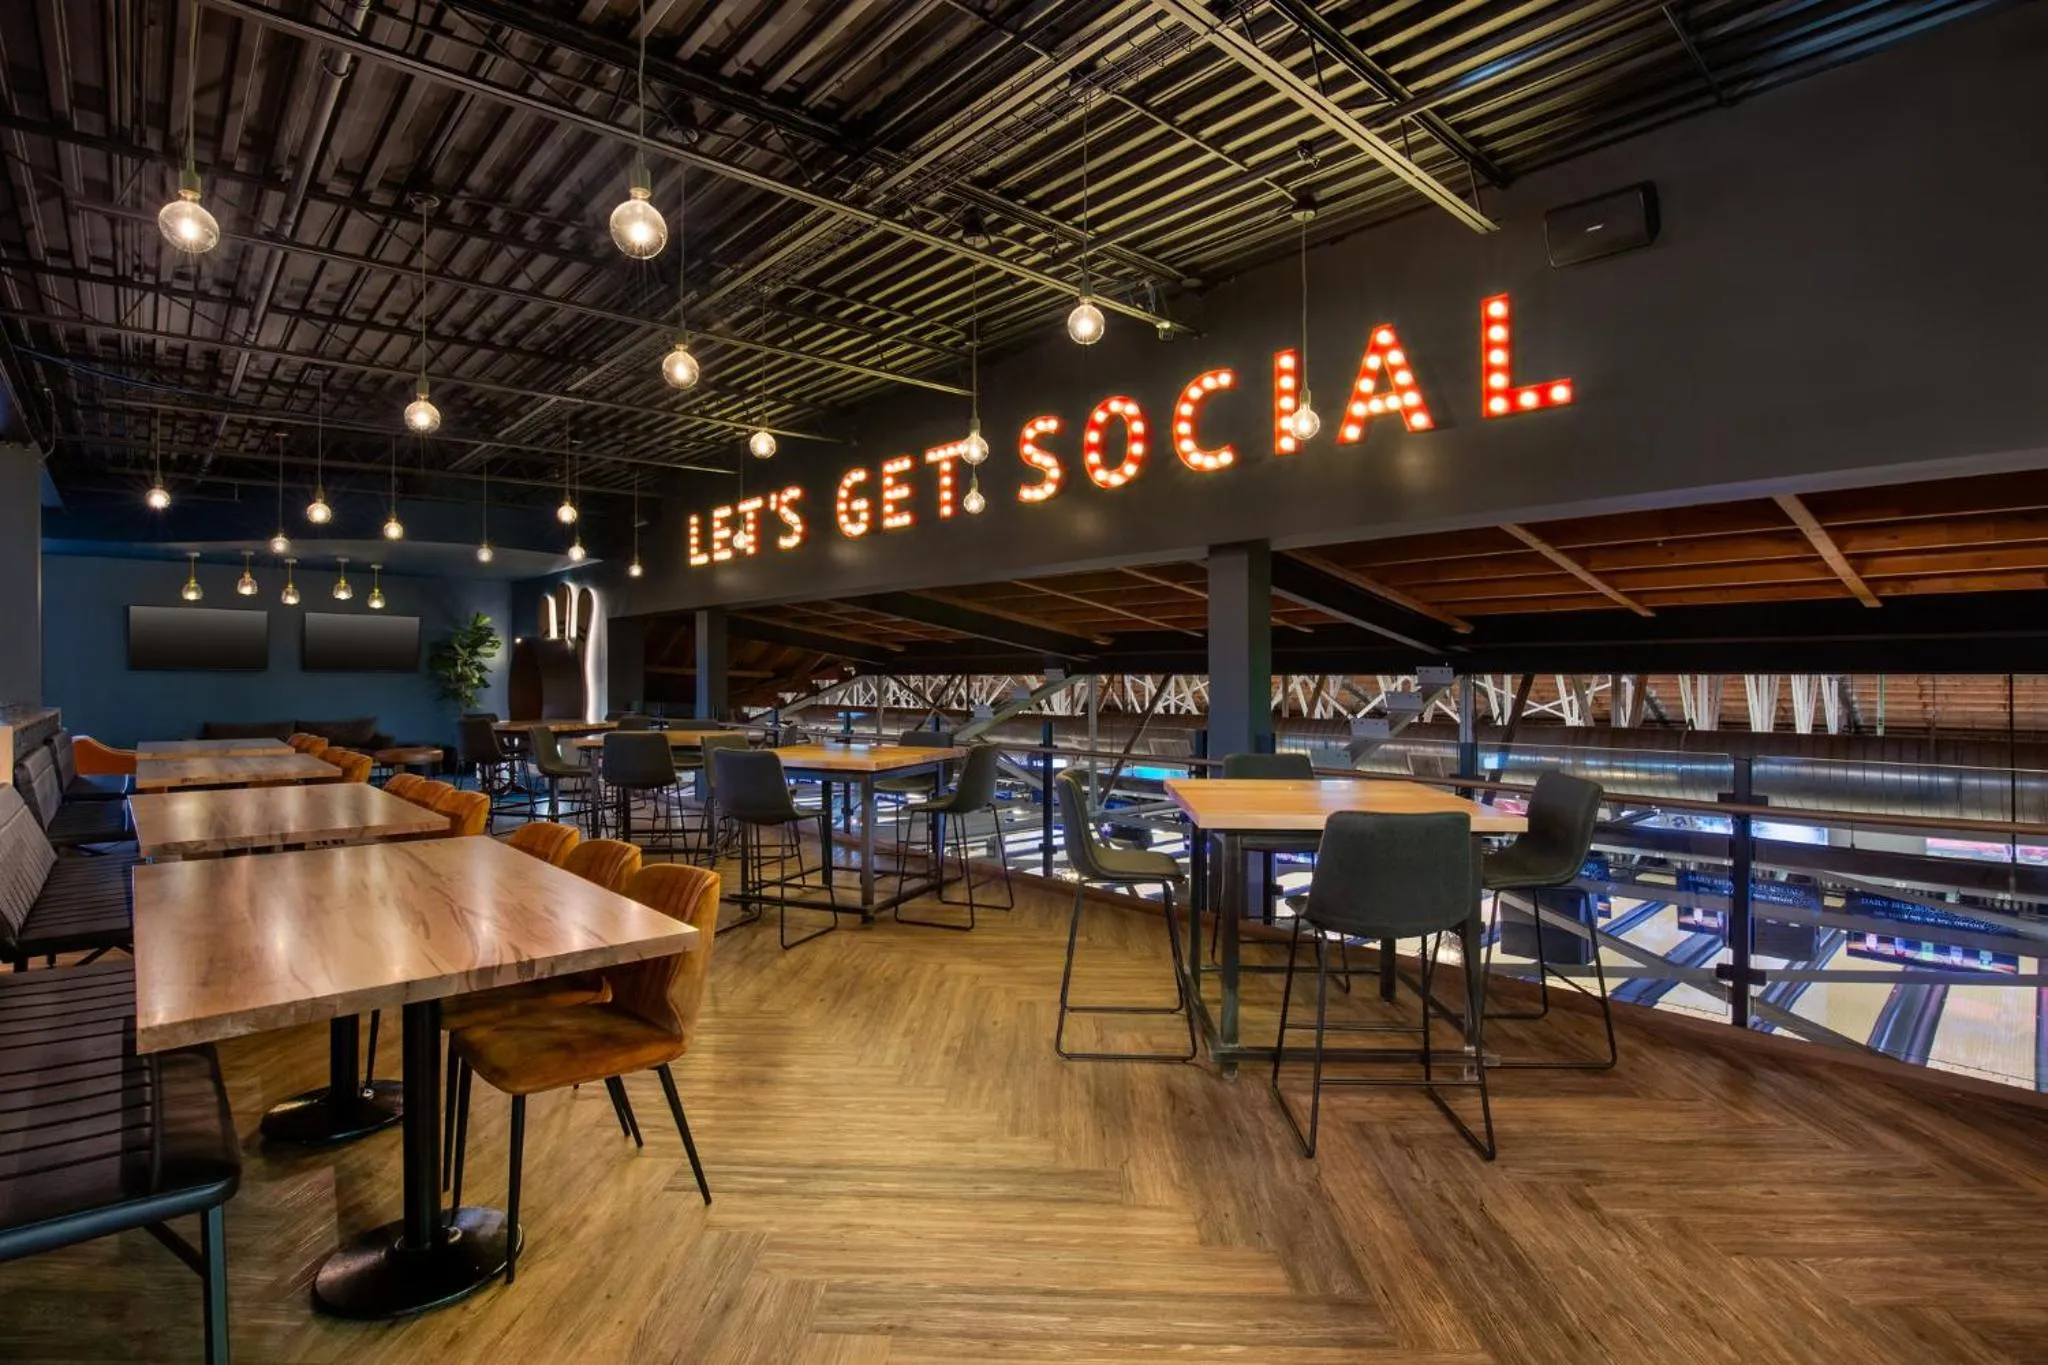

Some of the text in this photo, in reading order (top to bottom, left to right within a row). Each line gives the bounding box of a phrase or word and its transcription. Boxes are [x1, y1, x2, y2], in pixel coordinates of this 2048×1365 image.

[688, 292, 1573, 566] LET'S GET SOCIAL
